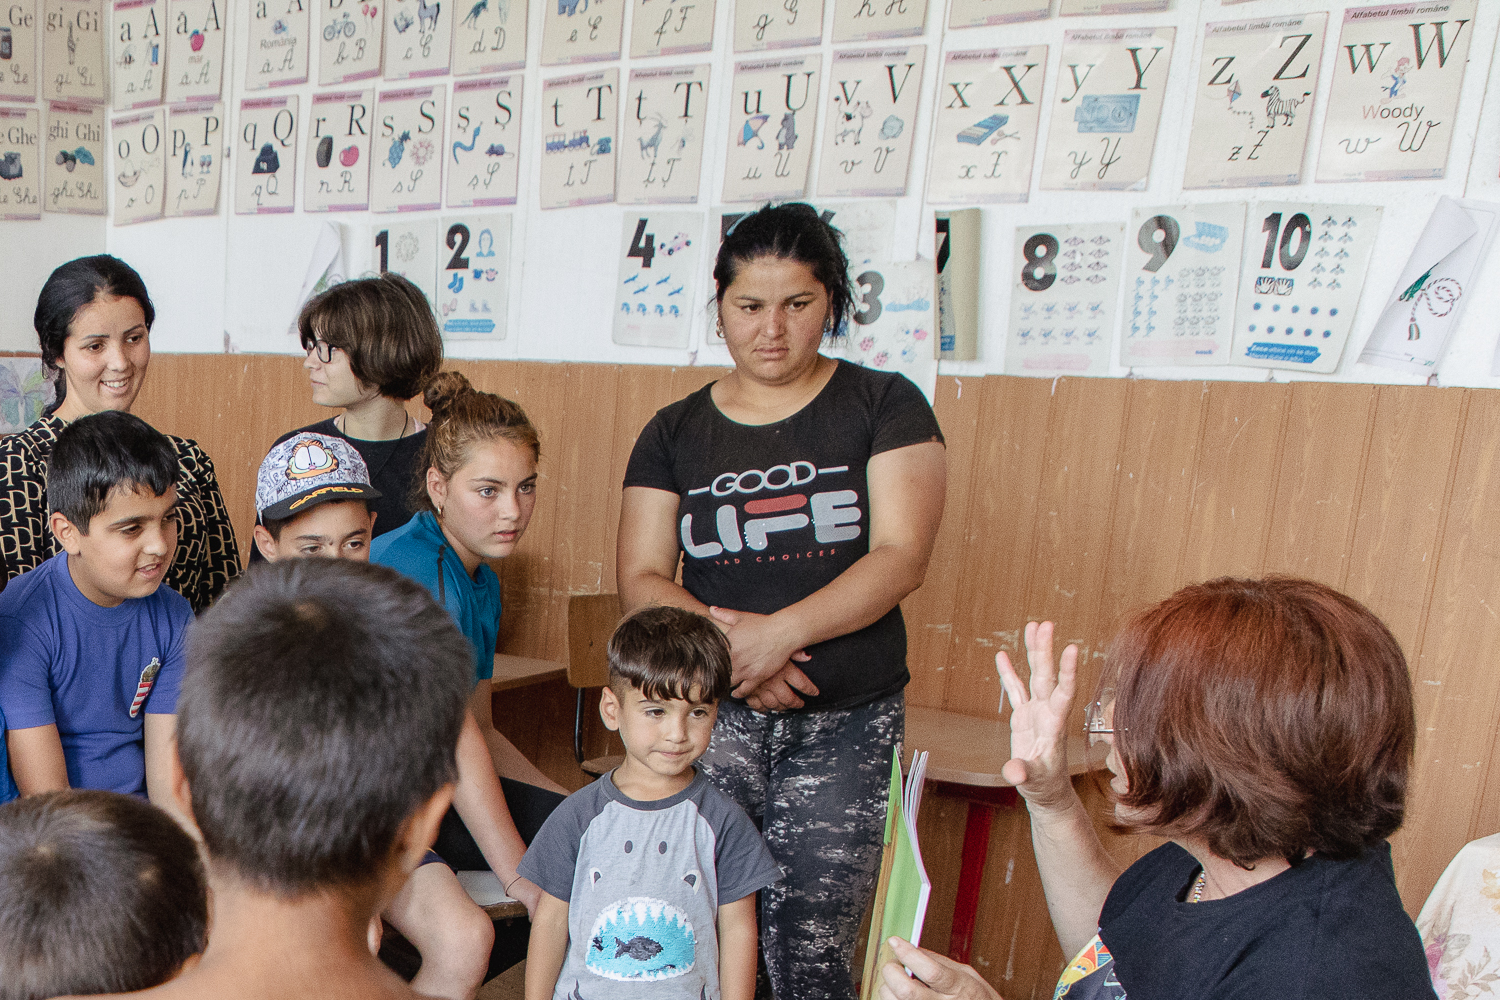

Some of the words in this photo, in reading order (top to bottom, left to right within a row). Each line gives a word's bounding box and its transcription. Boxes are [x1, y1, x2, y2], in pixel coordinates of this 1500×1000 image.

[8, 5, 33, 28] Ge
[46, 7, 63, 32] gi
[76, 9, 98, 32] Gi
[120, 22, 131, 42] a
[143, 7, 160, 39] A
[752, 14, 774, 41] g
[1212, 23, 1248, 33] Alfabetul
[1272, 18, 1304, 28] române
[1351, 8, 1389, 20] Alfabetul
[1390, 6, 1415, 17] limbii
[1416, 4, 1450, 15] române
[469, 28, 487, 54] d
[491, 26, 506, 51] D
[1207, 56, 1236, 87] z
[1272, 33, 1314, 81] Z
[1343, 41, 1392, 75] w
[1408, 19, 1471, 71] W
[742, 89, 763, 115] u
[782, 71, 815, 112] U
[838, 79, 862, 106] v
[885, 62, 916, 105] V
[945, 82, 973, 109] x
[994, 63, 1039, 107] X
[1061, 63, 1096, 103] y
[1125, 47, 1164, 91] Y
[313, 117, 326, 138] r
[344, 103, 368, 136] R
[381, 115, 395, 138] s
[418, 99, 435, 134] S
[552, 97, 565, 127] t
[586, 84, 613, 121] T
[1362, 103, 1425, 121] Woody
[8, 126, 37, 145] Ghe
[48, 120, 69, 142] ghi
[75, 122, 101, 142] Ghi
[141, 123, 160, 154] O
[171, 129, 186, 157] p
[202, 116, 219, 146] P
[243, 122, 258, 151] q
[273, 109, 294, 147] Q
[375, 229, 389, 273] 1
[445, 222, 471, 270] 2
[626, 217, 656, 268] 4
[1021, 232, 1060, 292] 8
[1137, 214, 1180, 273] 9
[1261, 212, 1312, 271] 10
[853, 270, 885, 325] 3
[711, 460, 817, 497] GOOD
[680, 489, 862, 559] LIFE
[756, 548, 836, 563] CHOICES
